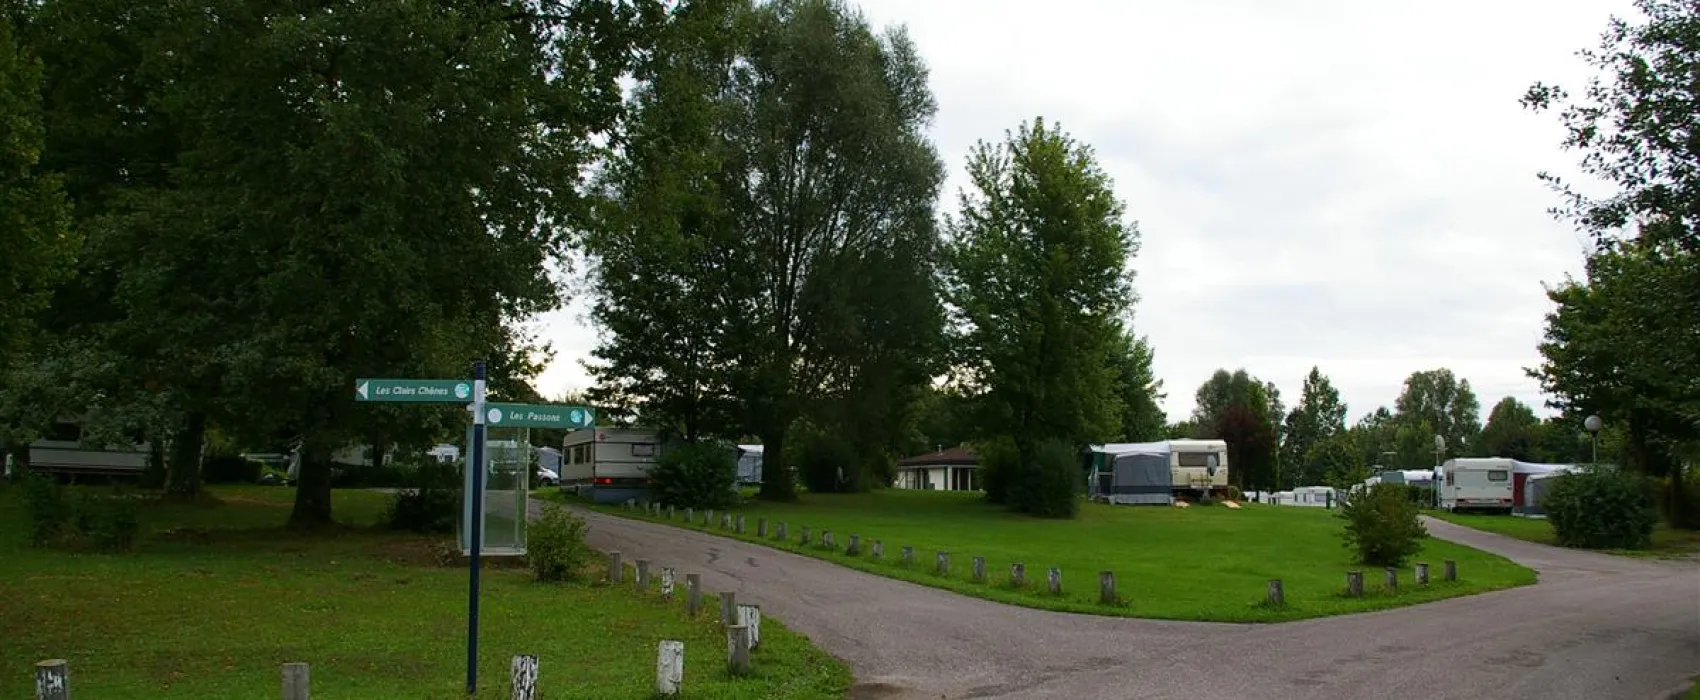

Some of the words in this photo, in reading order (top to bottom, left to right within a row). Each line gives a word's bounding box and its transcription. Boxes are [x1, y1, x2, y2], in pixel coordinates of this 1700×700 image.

[376, 386, 391, 395] Les
[393, 386, 416, 395] Clairs
[417, 386, 448, 395] Chênes
[509, 411, 524, 420] Les
[527, 411, 561, 422] Passons
